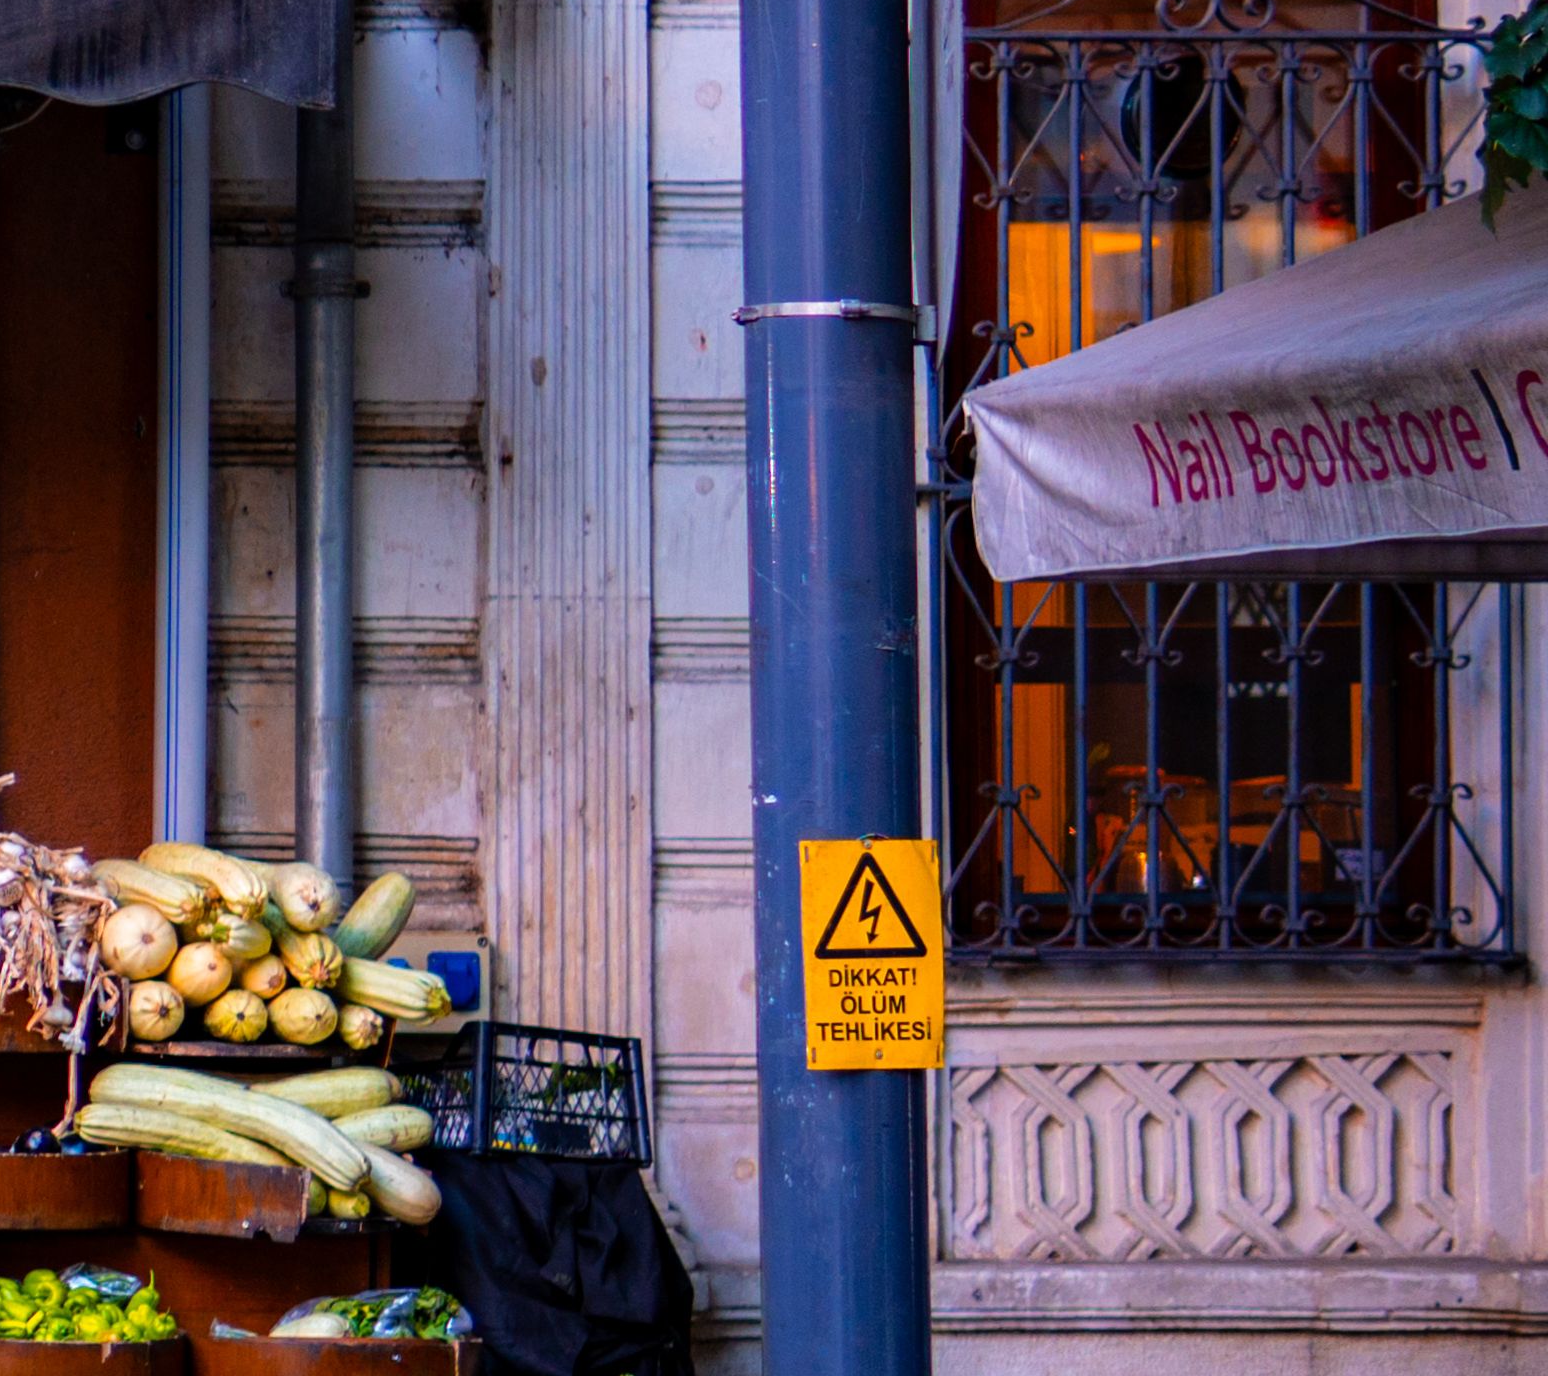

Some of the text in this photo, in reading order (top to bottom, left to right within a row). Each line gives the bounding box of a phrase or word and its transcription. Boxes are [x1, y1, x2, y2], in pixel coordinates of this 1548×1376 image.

[1133, 409, 1235, 507] Nail
[1228, 395, 1488, 495] Bookstore
[829, 964, 917, 988] DİKKAT!
[841, 991, 906, 1014] ÖLÜM
[816, 1017, 932, 1042] TEHLİKESİ
